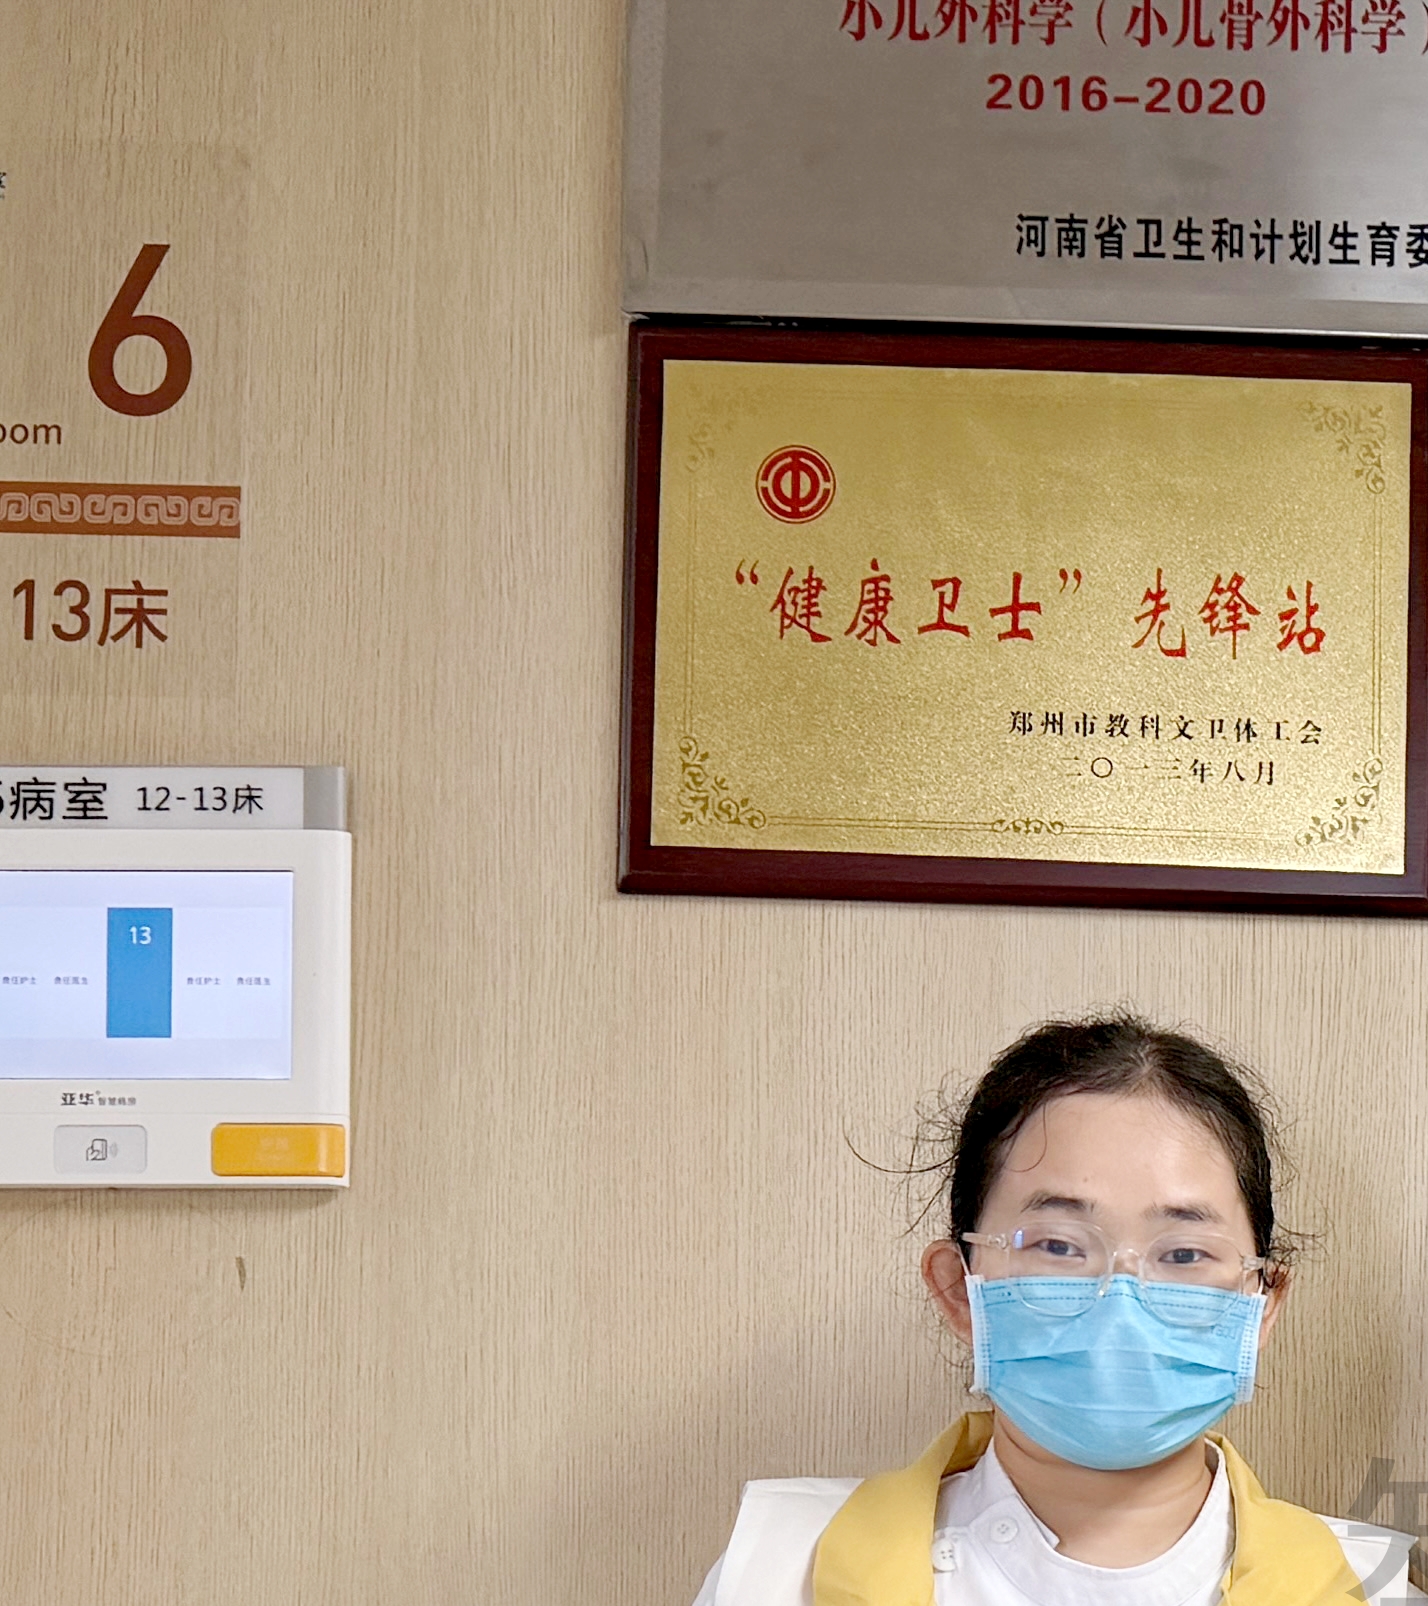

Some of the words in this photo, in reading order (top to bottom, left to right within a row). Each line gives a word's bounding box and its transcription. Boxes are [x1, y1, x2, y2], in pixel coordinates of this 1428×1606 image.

[985, 74, 1266, 116] 2016-2020
[88, 243, 192, 418] 6
[0, 424, 62, 446] om
[1009, 710, 1322, 745] 郑州市教科文卫体工会
[0, 777, 108, 820] 病室
[137, 784, 264, 814] 12-13床
[129, 926, 152, 945] 13
